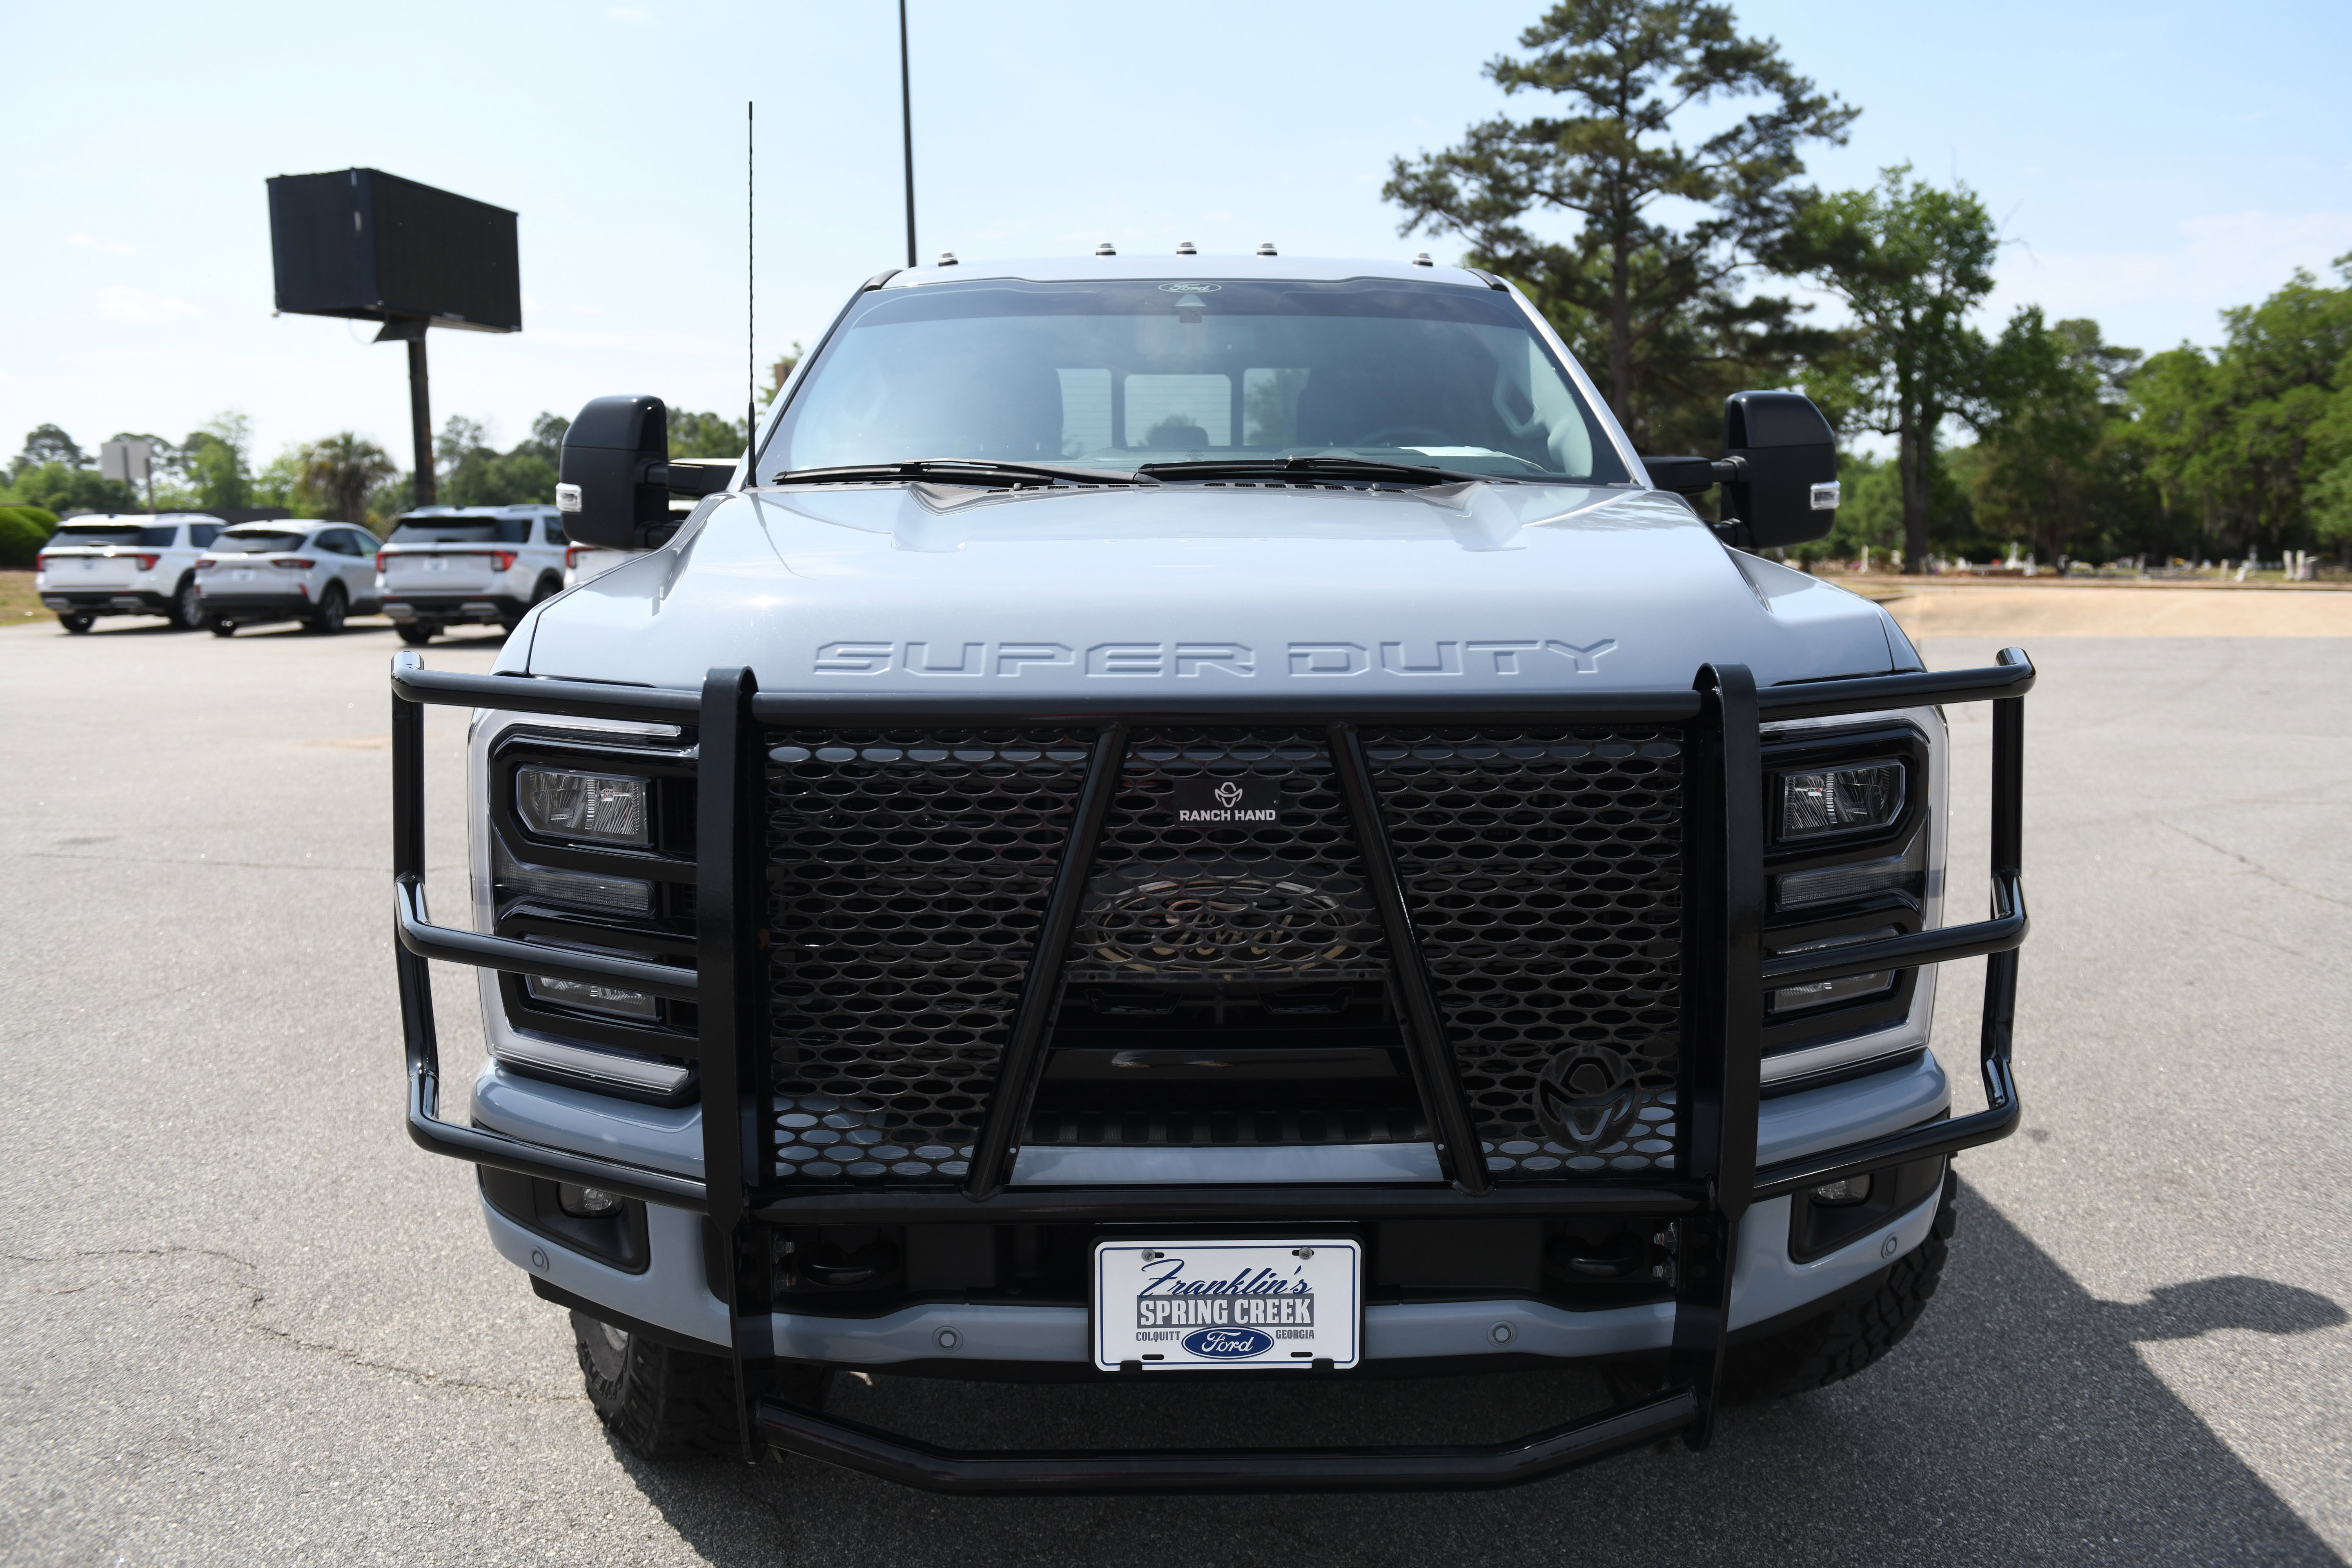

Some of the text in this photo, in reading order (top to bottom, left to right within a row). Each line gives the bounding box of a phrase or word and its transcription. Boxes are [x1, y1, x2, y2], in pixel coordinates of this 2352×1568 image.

[1169, 283, 1211, 291] Ford
[814, 638, 1618, 677] SUPER DUTY
[1179, 809, 1276, 821] RANCH HAND
[1138, 1259, 1313, 1299] Franklin's
[1140, 1298, 1311, 1325] SPRING CREEK
[1136, 1331, 1181, 1342] COLQUITT
[1201, 1331, 1254, 1352] Ford
[1276, 1329, 1315, 1340] GEORGIA
